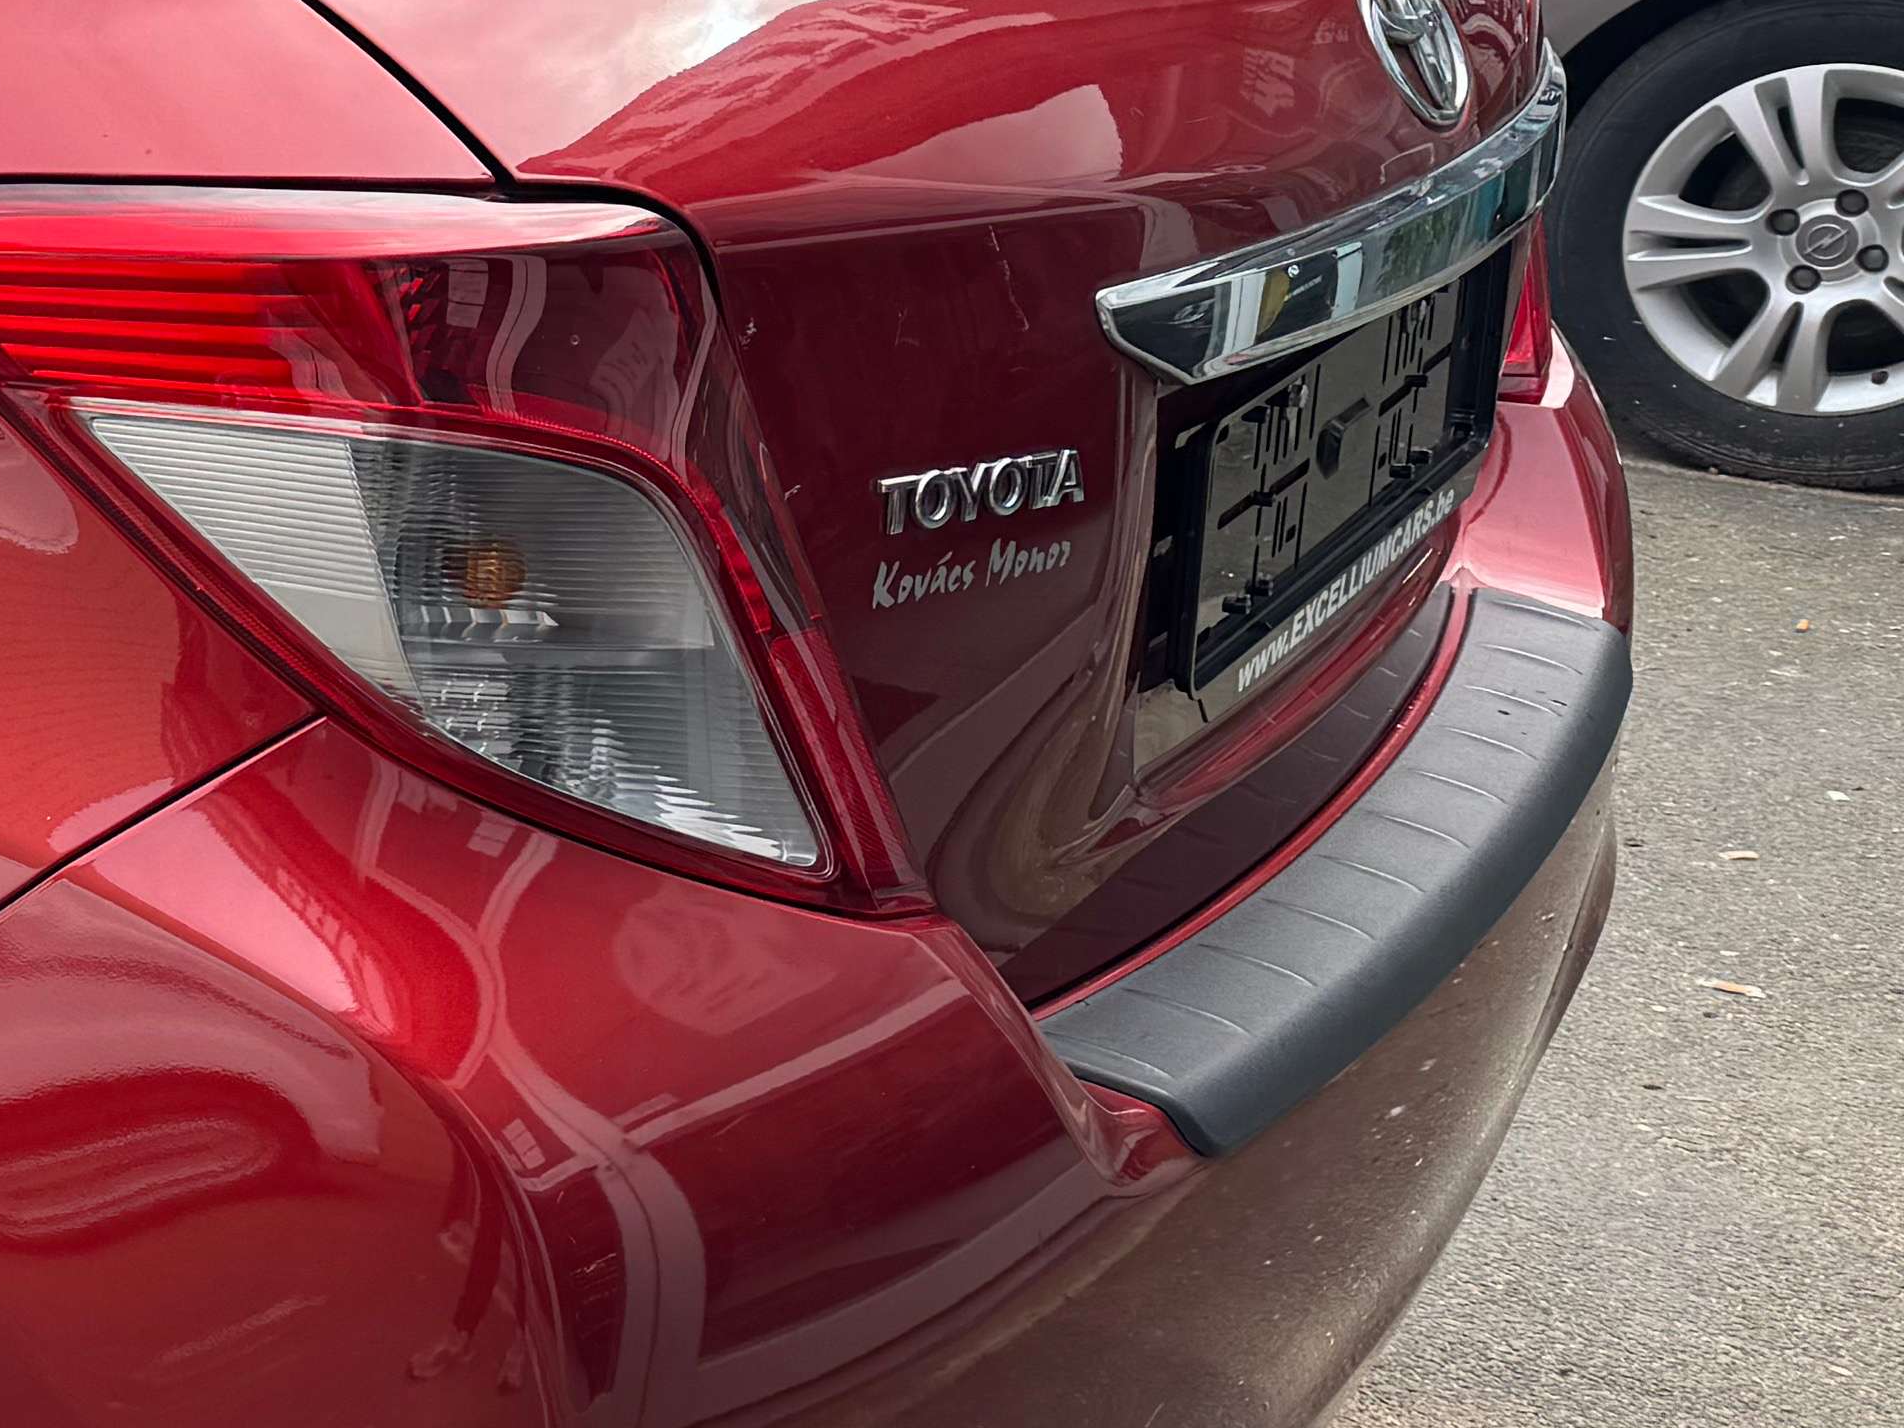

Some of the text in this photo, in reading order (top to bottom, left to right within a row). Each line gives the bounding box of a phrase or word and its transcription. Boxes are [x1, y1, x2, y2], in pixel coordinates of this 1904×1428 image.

[876, 449, 1085, 536] TOYOTA
[872, 538, 1072, 610] Kovács Monor
[1237, 488, 1455, 693] www.EXCELLIUMCARS.be
